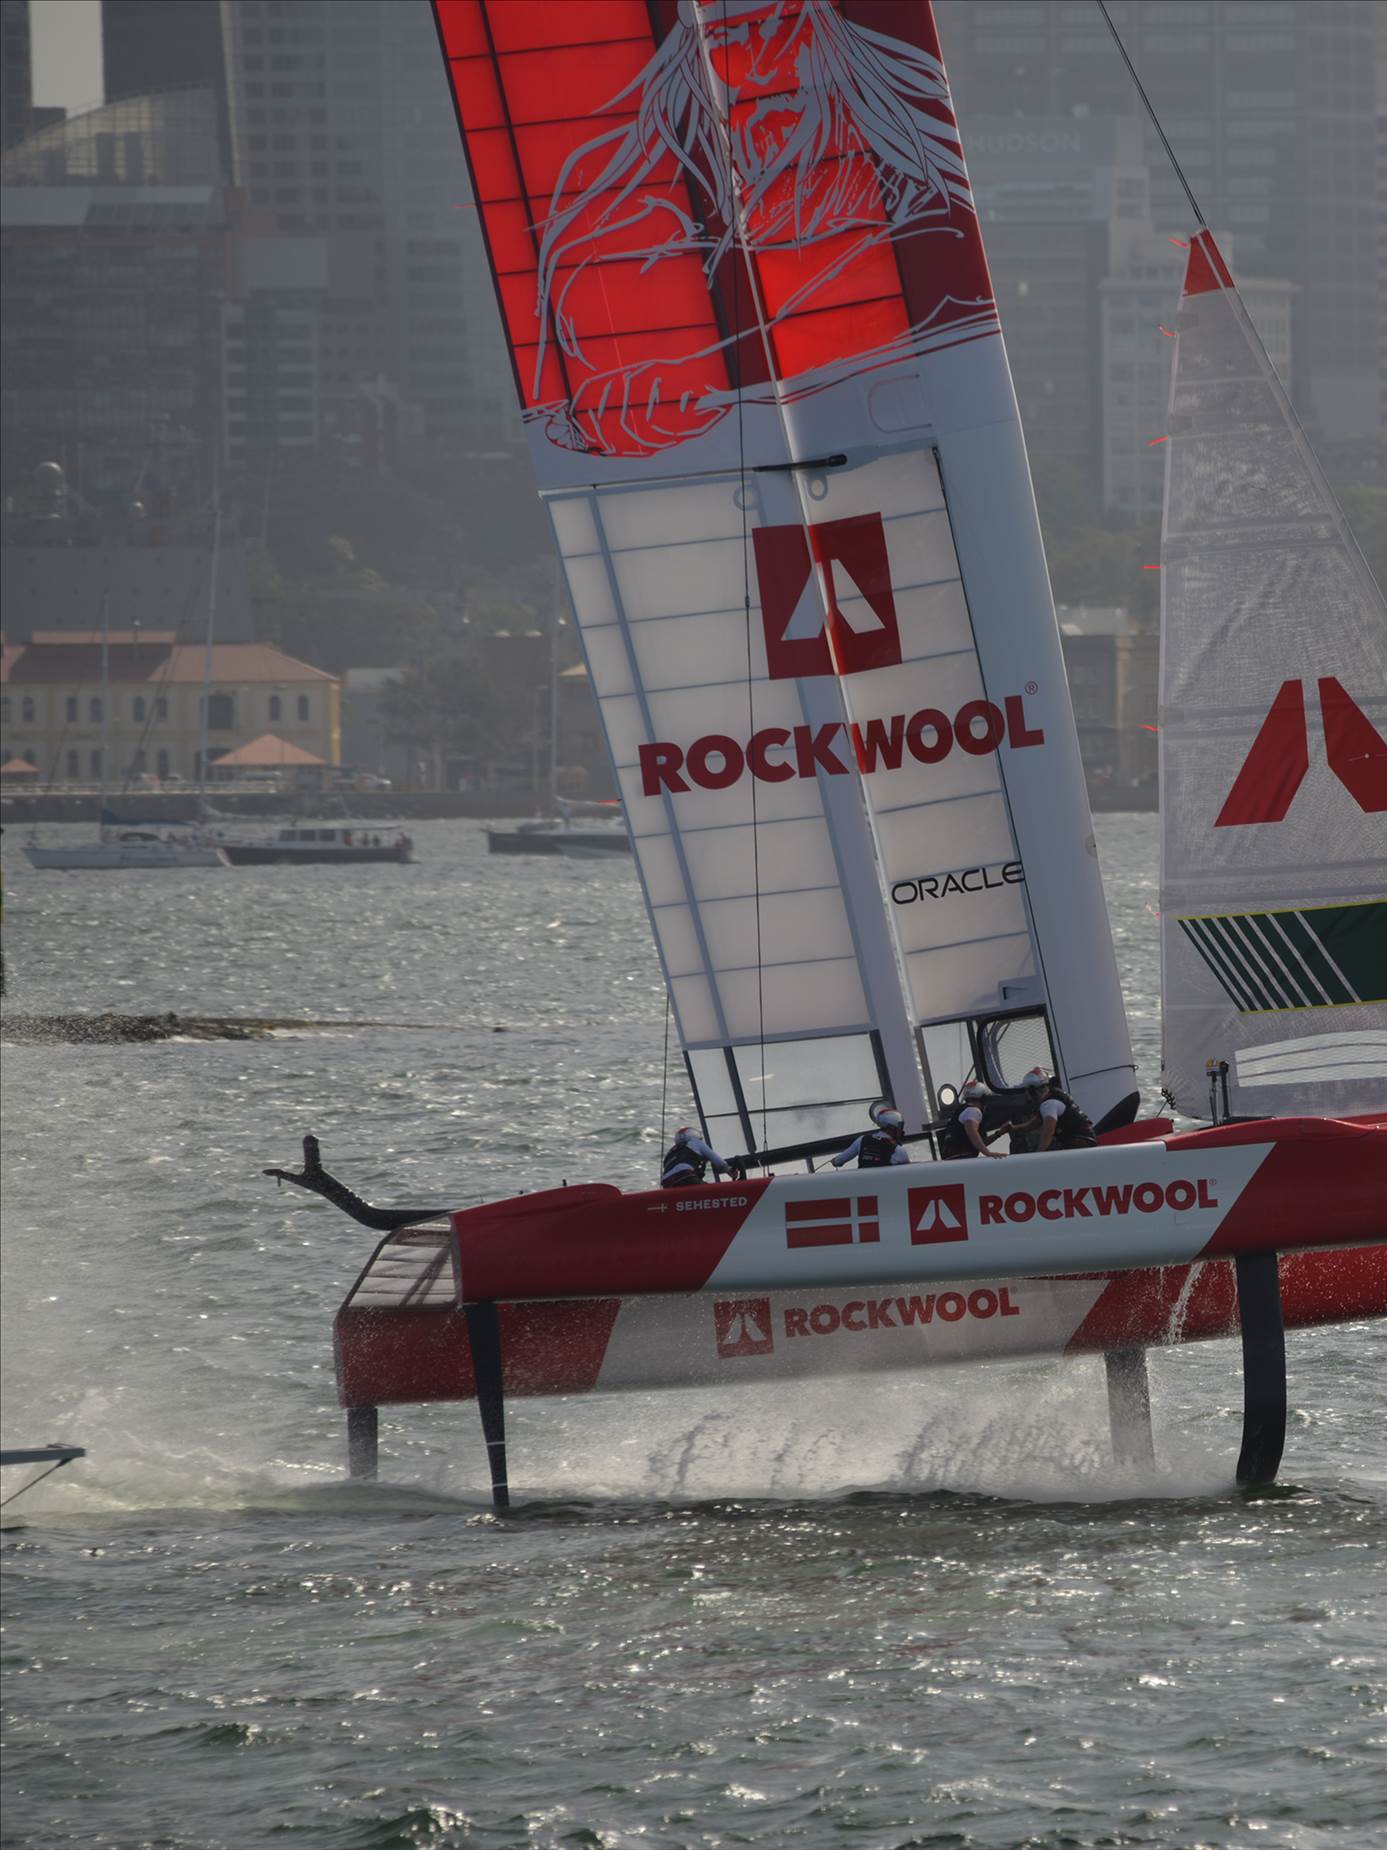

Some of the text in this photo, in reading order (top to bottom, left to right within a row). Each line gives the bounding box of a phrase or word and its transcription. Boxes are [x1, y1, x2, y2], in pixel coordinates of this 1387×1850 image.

[638, 695, 1045, 796] ROCKWOOL
[891, 860, 1025, 905] ORACLE
[675, 1197, 748, 1212] SEHESTED
[979, 1179, 1219, 1226] ROCKWOOL
[785, 1287, 1020, 1338] ROCKWOOL
